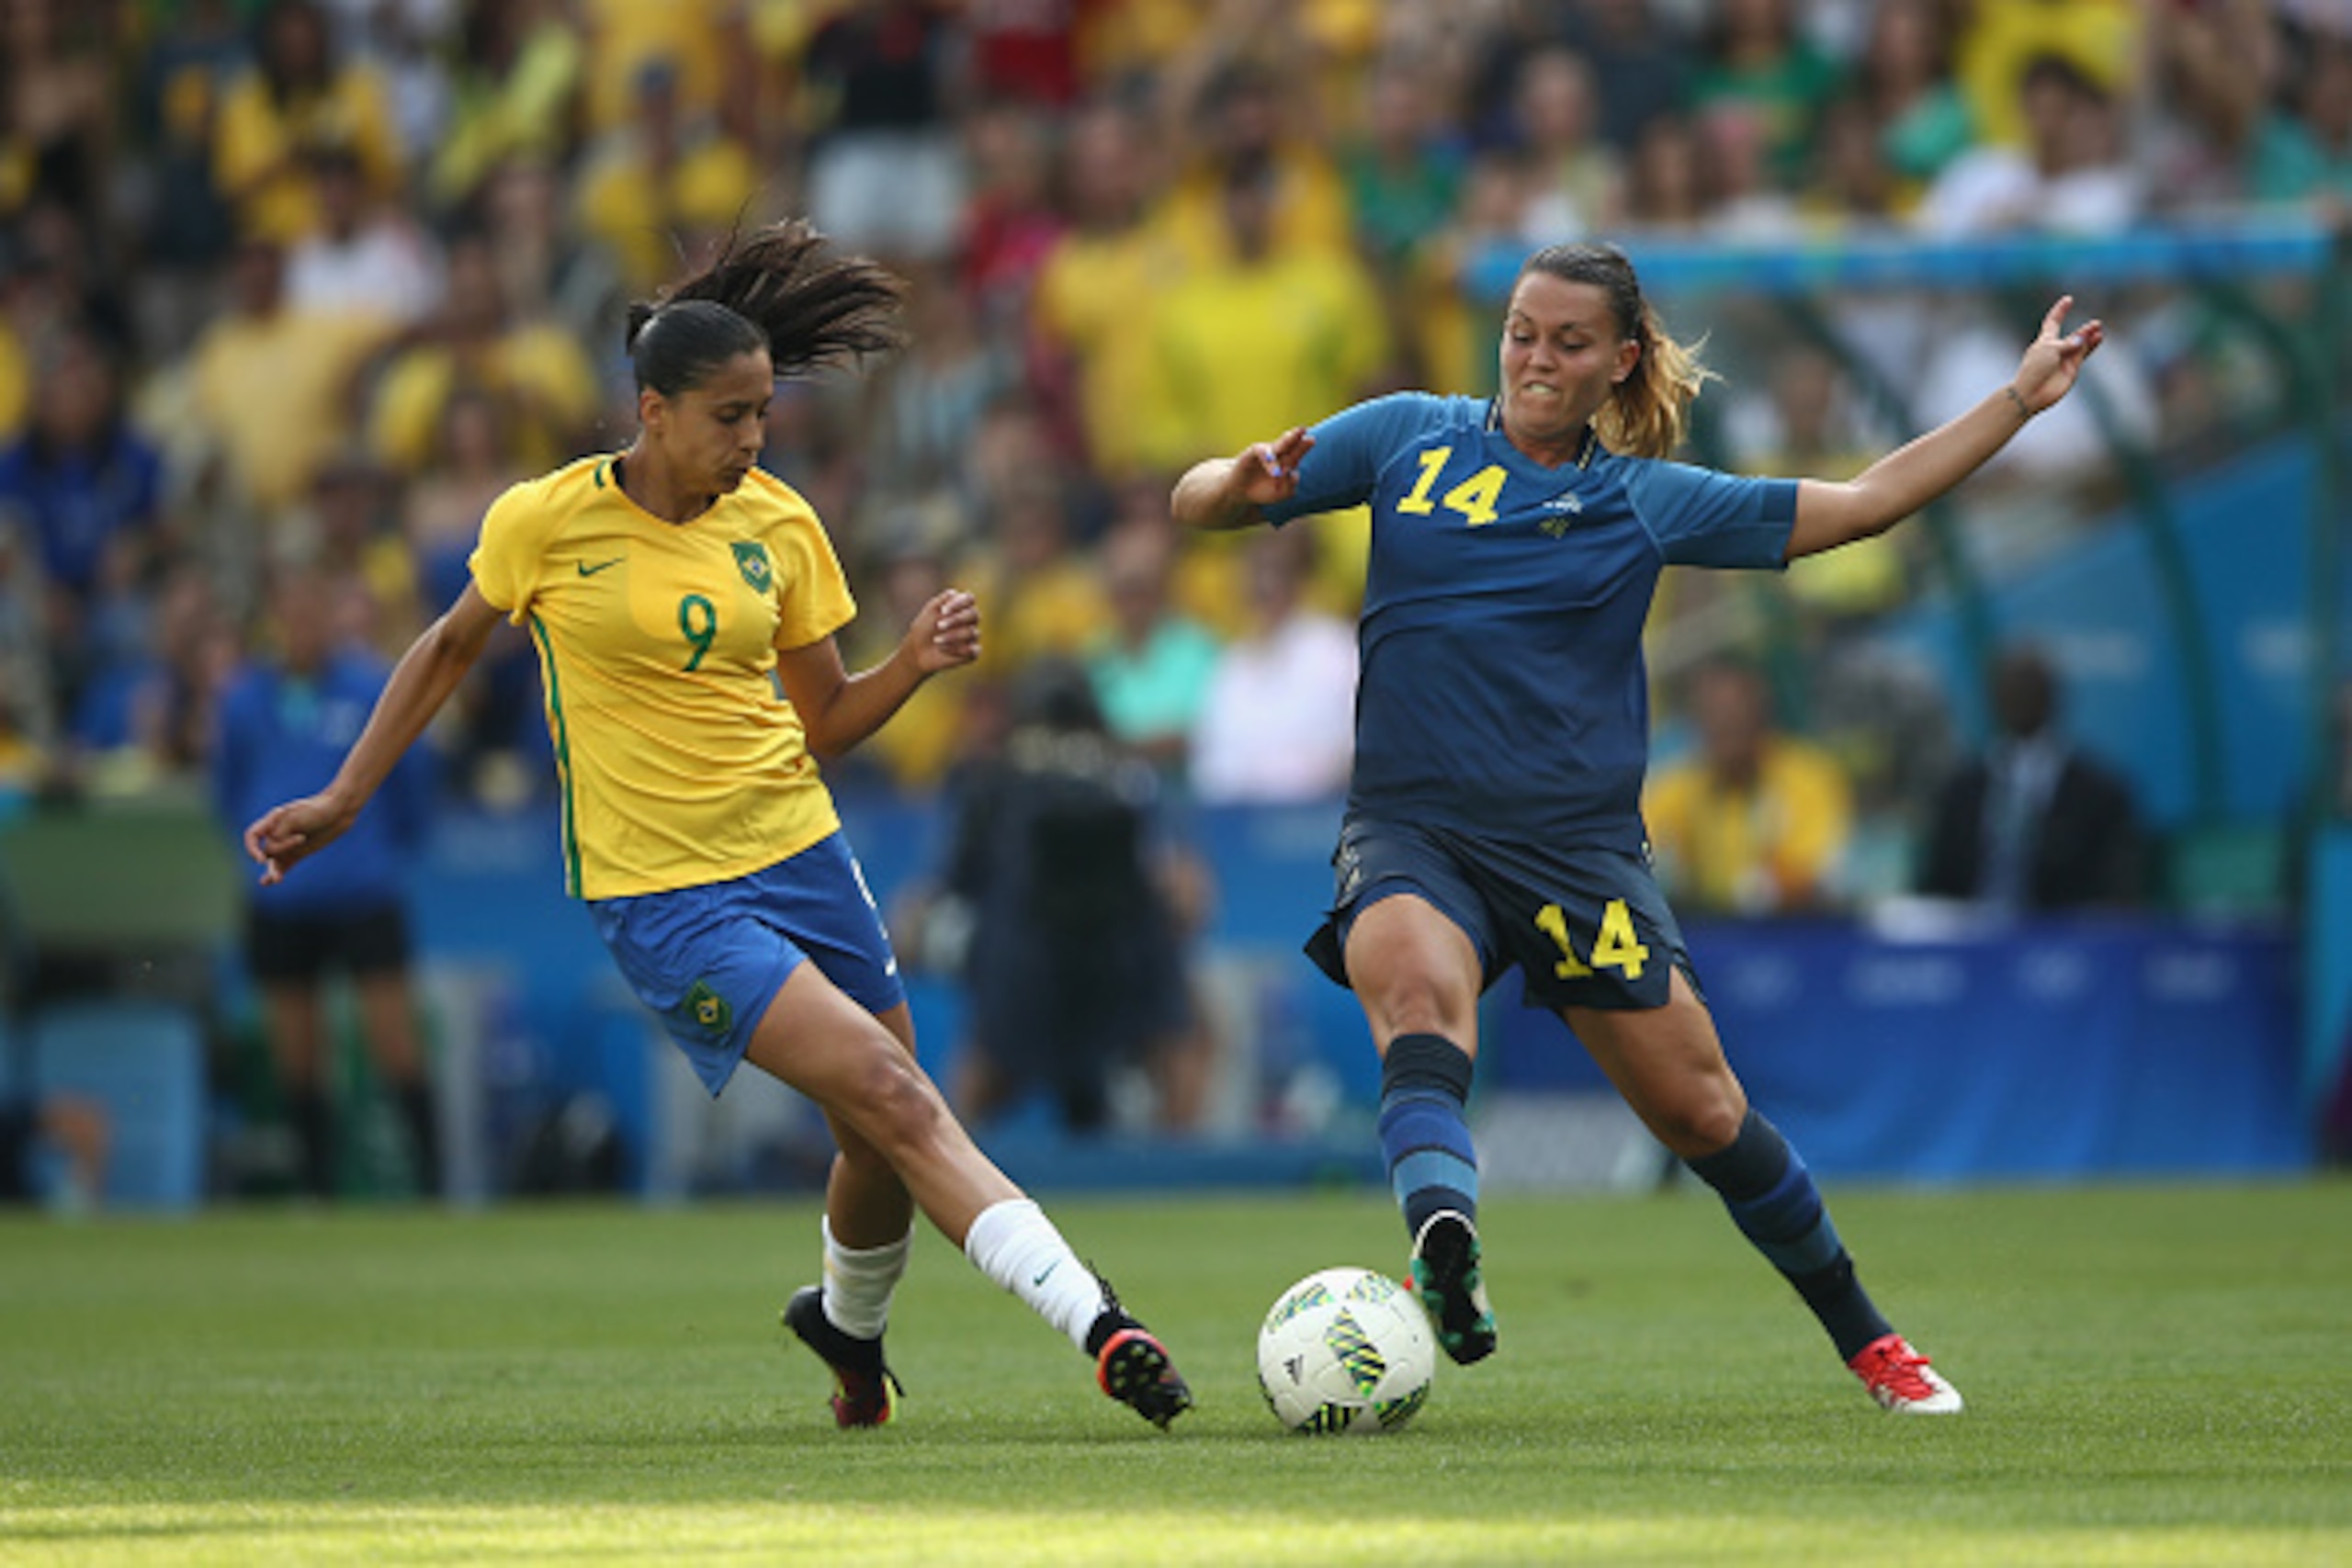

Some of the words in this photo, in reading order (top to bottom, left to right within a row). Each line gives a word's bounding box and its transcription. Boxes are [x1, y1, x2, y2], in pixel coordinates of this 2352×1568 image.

[1396, 446, 1508, 525] 14
[678, 593, 717, 671] 9
[1534, 897, 1649, 980] 14
